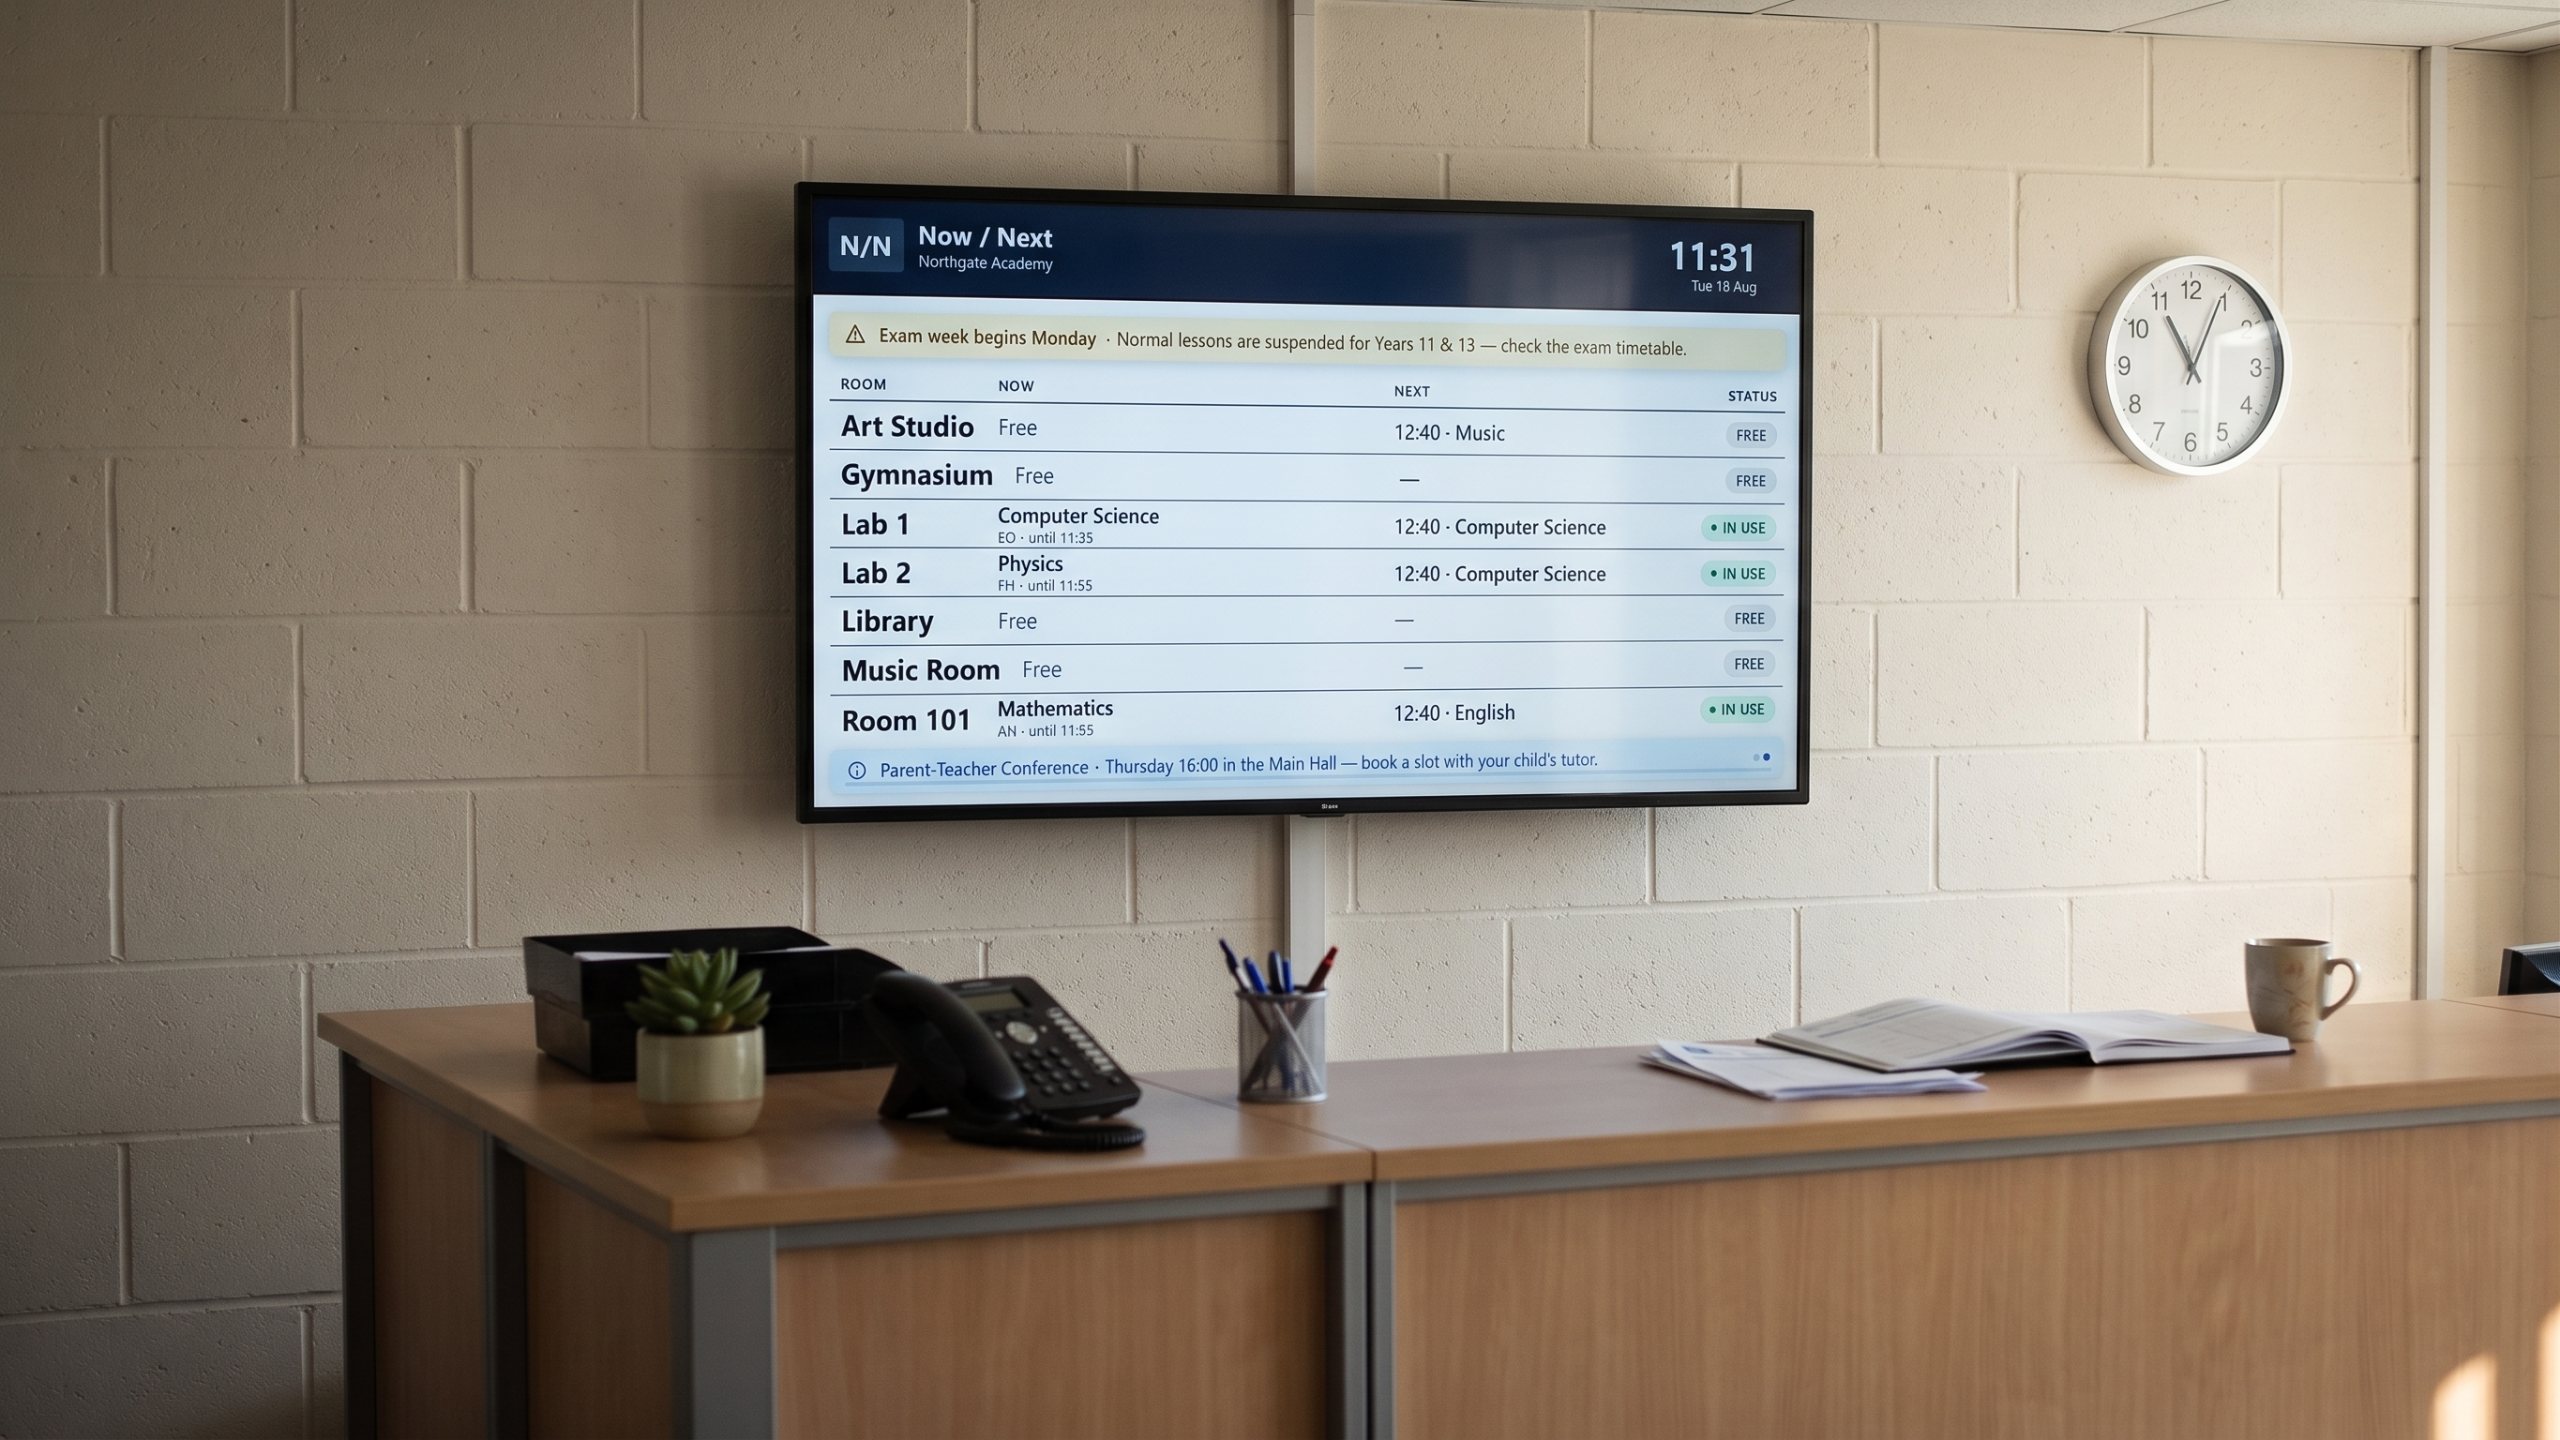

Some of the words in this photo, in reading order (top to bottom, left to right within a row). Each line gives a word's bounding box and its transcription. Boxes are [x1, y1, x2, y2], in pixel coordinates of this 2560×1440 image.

[920, 226, 972, 246] Now
[980, 227, 990, 248] /
[998, 227, 1052, 248] Next
[841, 235, 890, 258] N/N
[920, 255, 987, 272] Northgate
[991, 257, 1053, 274] Academy
[1672, 242, 1752, 272] 11:31
[1692, 280, 1712, 292] Tue
[1717, 281, 1730, 292] 18
[1734, 281, 1756, 296] Aug
[2181, 280, 2201, 299] 12
[2152, 292, 2167, 310] 11
[2220, 293, 2226, 311] 1
[2128, 319, 2148, 338] 10
[880, 328, 922, 343] Exam
[928, 329, 969, 343] week
[975, 329, 1026, 348] begins
[1033, 331, 1096, 350] Monday
[1118, 332, 1172, 347] Normal
[1179, 332, 1232, 348] lessons
[1238, 337, 1260, 348] are
[1266, 334, 1344, 353] suspended
[1350, 335, 1370, 350] for
[1375, 336, 1413, 351] Years
[1420, 337, 1433, 351] 11
[1440, 337, 1453, 352] &
[1459, 338, 1474, 352] 13
[1501, 338, 1542, 353] check
[1546, 339, 1569, 353] the
[1574, 343, 1611, 354] exam
[1616, 341, 1686, 356] timetable.
[2118, 356, 2130, 375] 9
[2250, 359, 2262, 377] 3
[842, 378, 885, 390] ROOM
[999, 380, 1034, 391] NOW
[1395, 386, 1430, 397] NEXT
[1729, 391, 1777, 402] STATUS
[2129, 394, 2141, 413] 8
[2240, 396, 2252, 414] 4
[841, 415, 883, 436] Art
[892, 415, 974, 437] Studio
[1000, 419, 1037, 436] Free
[1396, 424, 1440, 440] 12:40
[1456, 425, 1504, 441] Music
[2153, 422, 2165, 441] 7
[2217, 423, 2228, 441] 5
[1737, 430, 1766, 441] FREE
[2185, 433, 2197, 452] 6
[842, 463, 992, 492] Gymnasium
[1016, 467, 1053, 484] Free
[1737, 475, 1765, 487] FREE
[843, 512, 887, 535] Lab
[898, 513, 907, 535] 1
[999, 507, 1088, 528] Computer
[1094, 507, 1159, 524] Science
[1396, 519, 1440, 534] 12:40
[1456, 519, 1539, 539] Computer
[1544, 519, 1606, 535] Science
[1724, 522, 1736, 533] IN
[1742, 522, 1765, 534] USE
[999, 532, 1015, 543] EO
[1029, 532, 1055, 543] until
[1061, 532, 1093, 543] 11:35
[843, 561, 887, 584] Lab
[897, 562, 910, 583] 2
[999, 555, 1063, 576] Physics
[1723, 568, 1736, 579] IN
[1741, 568, 1765, 579] USE
[1395, 566, 1440, 581] 12:40
[1456, 566, 1539, 586] Computer
[1544, 565, 1606, 581] Science
[999, 580, 1014, 591] FH
[1028, 579, 1054, 591] until
[1060, 580, 1092, 591] 11:55
[843, 609, 934, 638] Library
[1000, 613, 1037, 629] Free
[1736, 613, 1764, 624] FREE
[844, 659, 917, 681] Music
[928, 659, 999, 680] Room
[1024, 661, 1061, 678] Free
[1735, 658, 1764, 670] FREE
[999, 699, 1113, 716] Mathematics
[1395, 705, 1440, 721] 12:40
[1456, 703, 1515, 725] English
[1722, 704, 1735, 715] IN
[1741, 703, 1764, 715] USE
[844, 710, 916, 731] Room
[927, 709, 968, 730] 101
[998, 726, 1016, 737] AN
[1029, 724, 1056, 736] until
[1062, 725, 1093, 736] 11:55
[881, 761, 997, 777] Parent-Teacher
[1002, 760, 1088, 775] Conference
[1105, 758, 1173, 777] Thursday
[1179, 758, 1218, 772] 16:00
[1224, 757, 1235, 771] in
[1241, 757, 1264, 771] the
[1270, 757, 1304, 770] Main
[1310, 755, 1336, 770] Hall
[1362, 755, 1397, 769] book
[1402, 759, 1409, 769] a
[1415, 754, 1439, 768] slot
[1444, 753, 1473, 768] with
[1478, 757, 1510, 772] your
[1514, 752, 1556, 767] child's
[1561, 754, 1597, 766] tutor.
